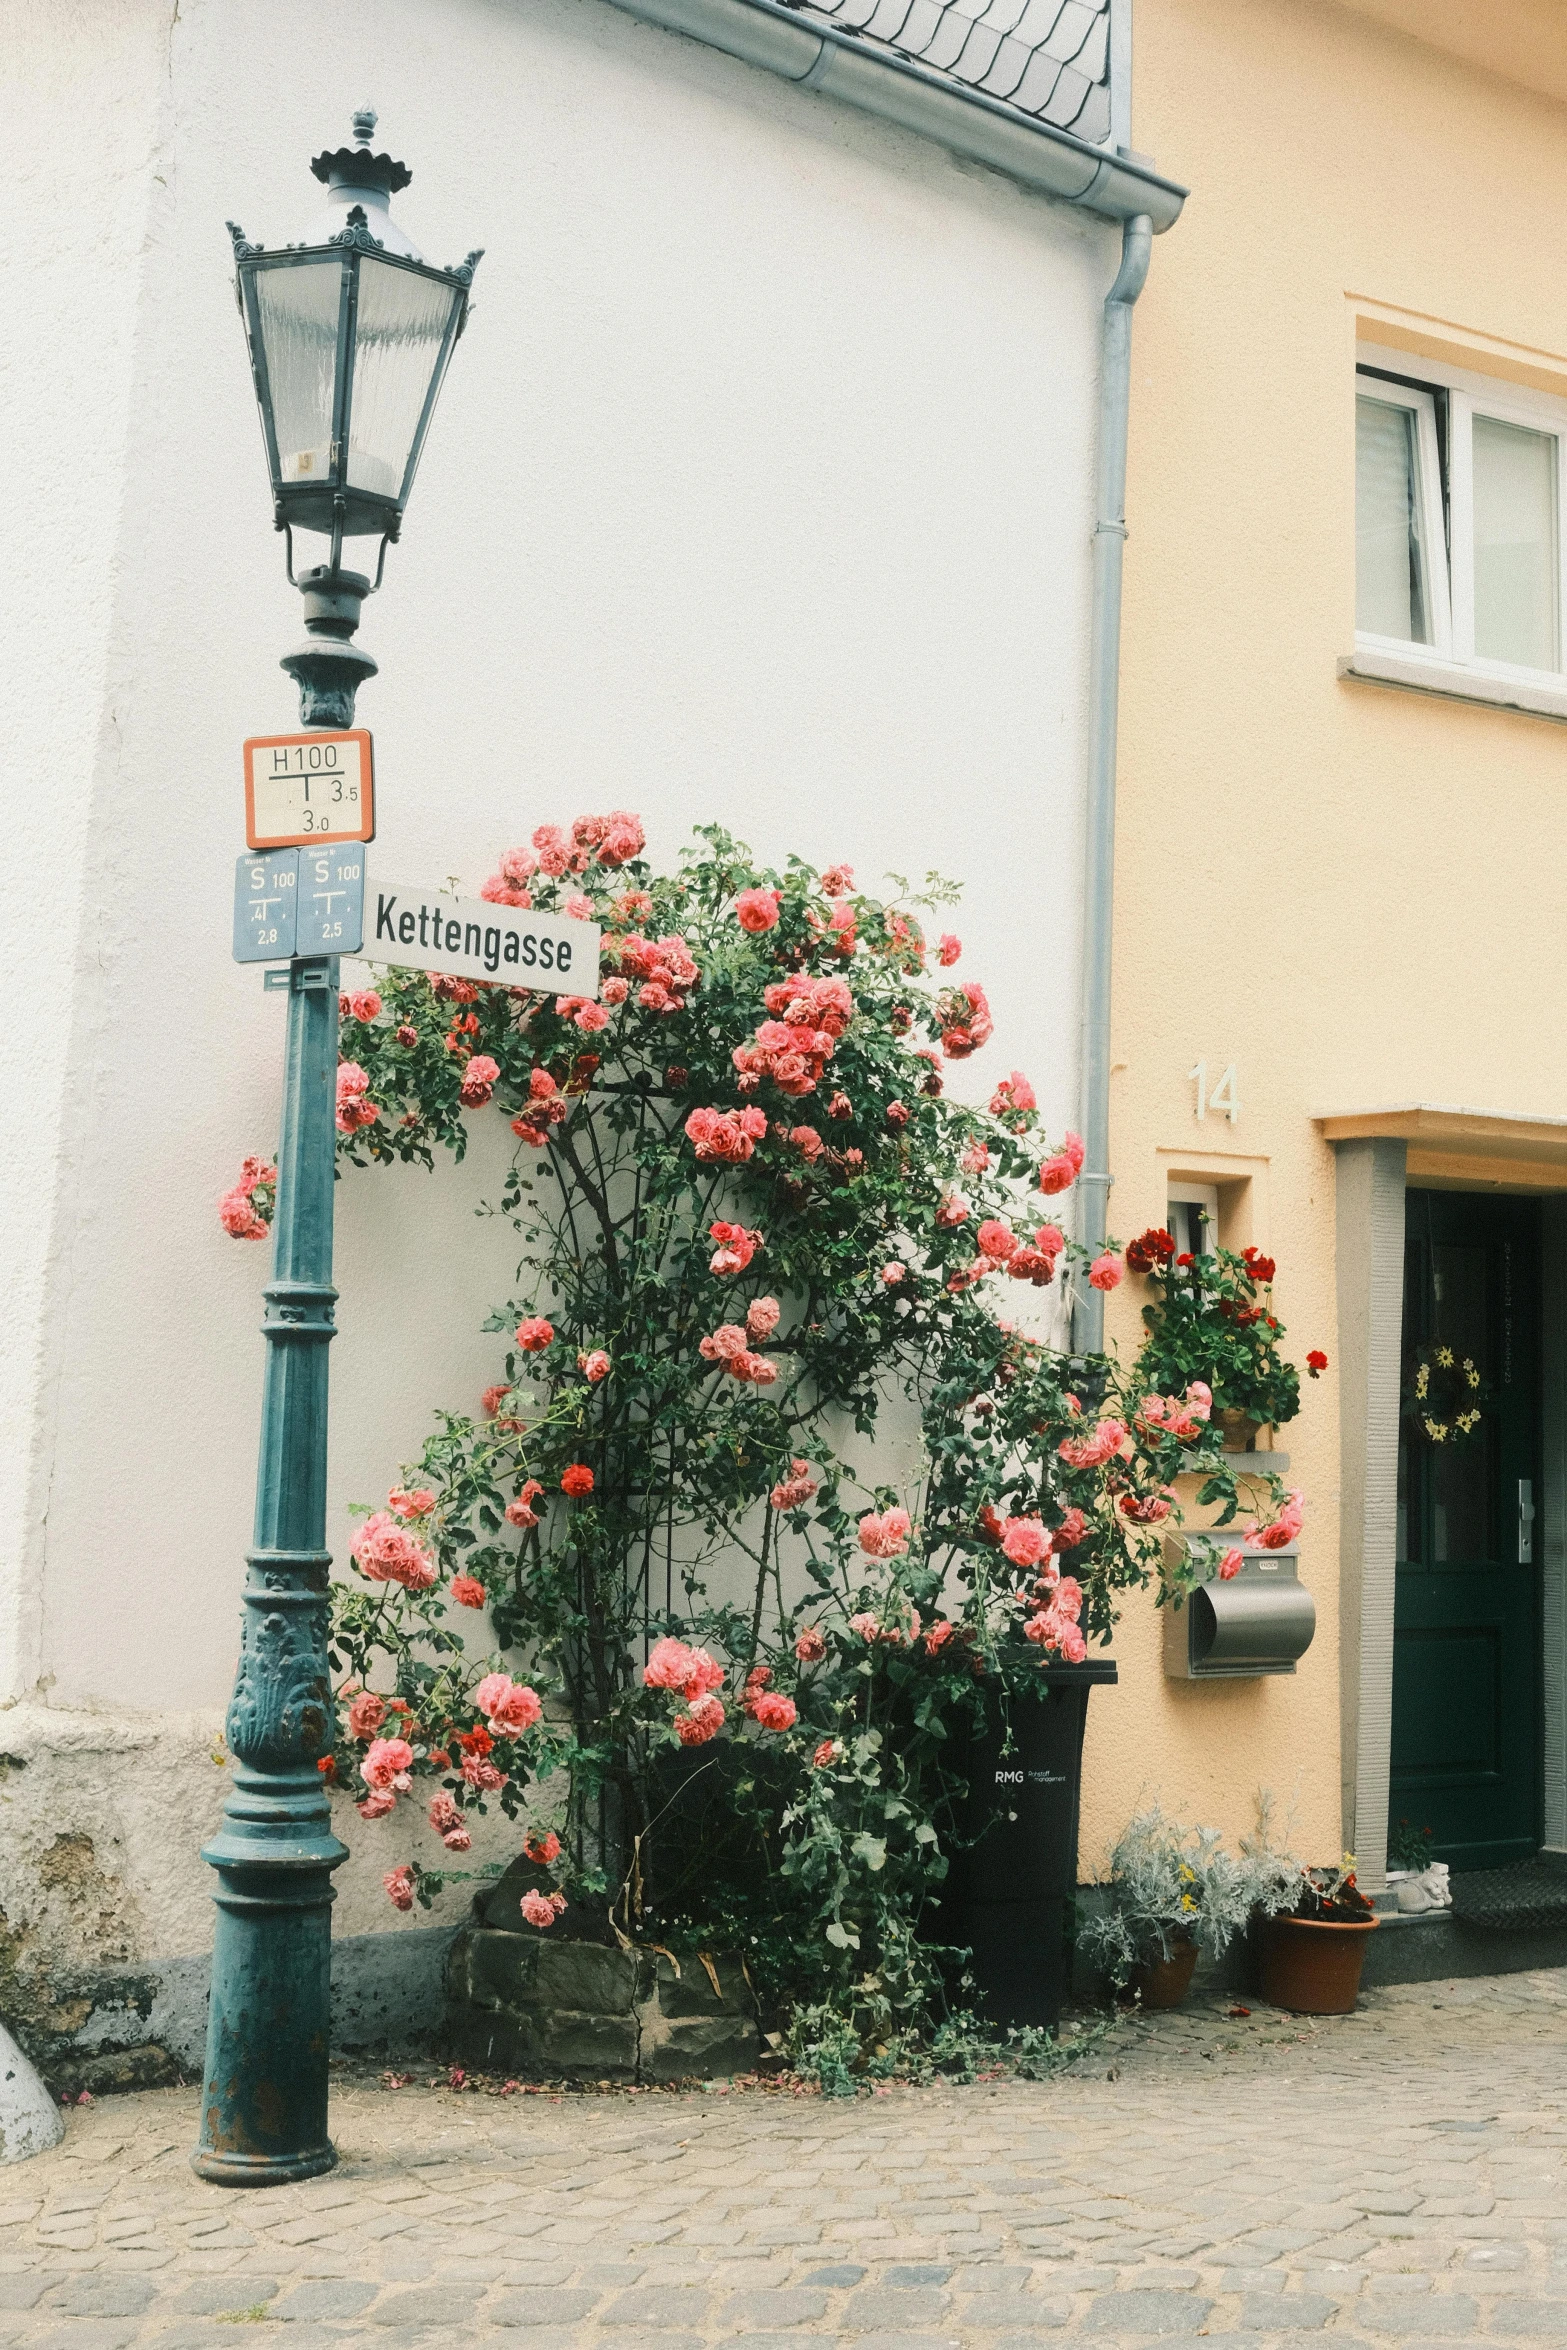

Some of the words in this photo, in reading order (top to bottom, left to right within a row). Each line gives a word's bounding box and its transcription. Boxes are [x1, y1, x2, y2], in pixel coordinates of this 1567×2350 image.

[303, 810, 329, 832] 3,0
[251, 867, 265, 890] S
[273, 872, 295, 888] 100
[315, 860, 329, 883] S
[337, 865, 360, 881] 100
[258, 928, 278, 945] 2,8
[322, 921, 342, 938] 2,5
[376, 893, 572, 973] Kettengasse
[1188, 1060, 1243, 1124] 14
[995, 1771, 1024, 1783] RMG
